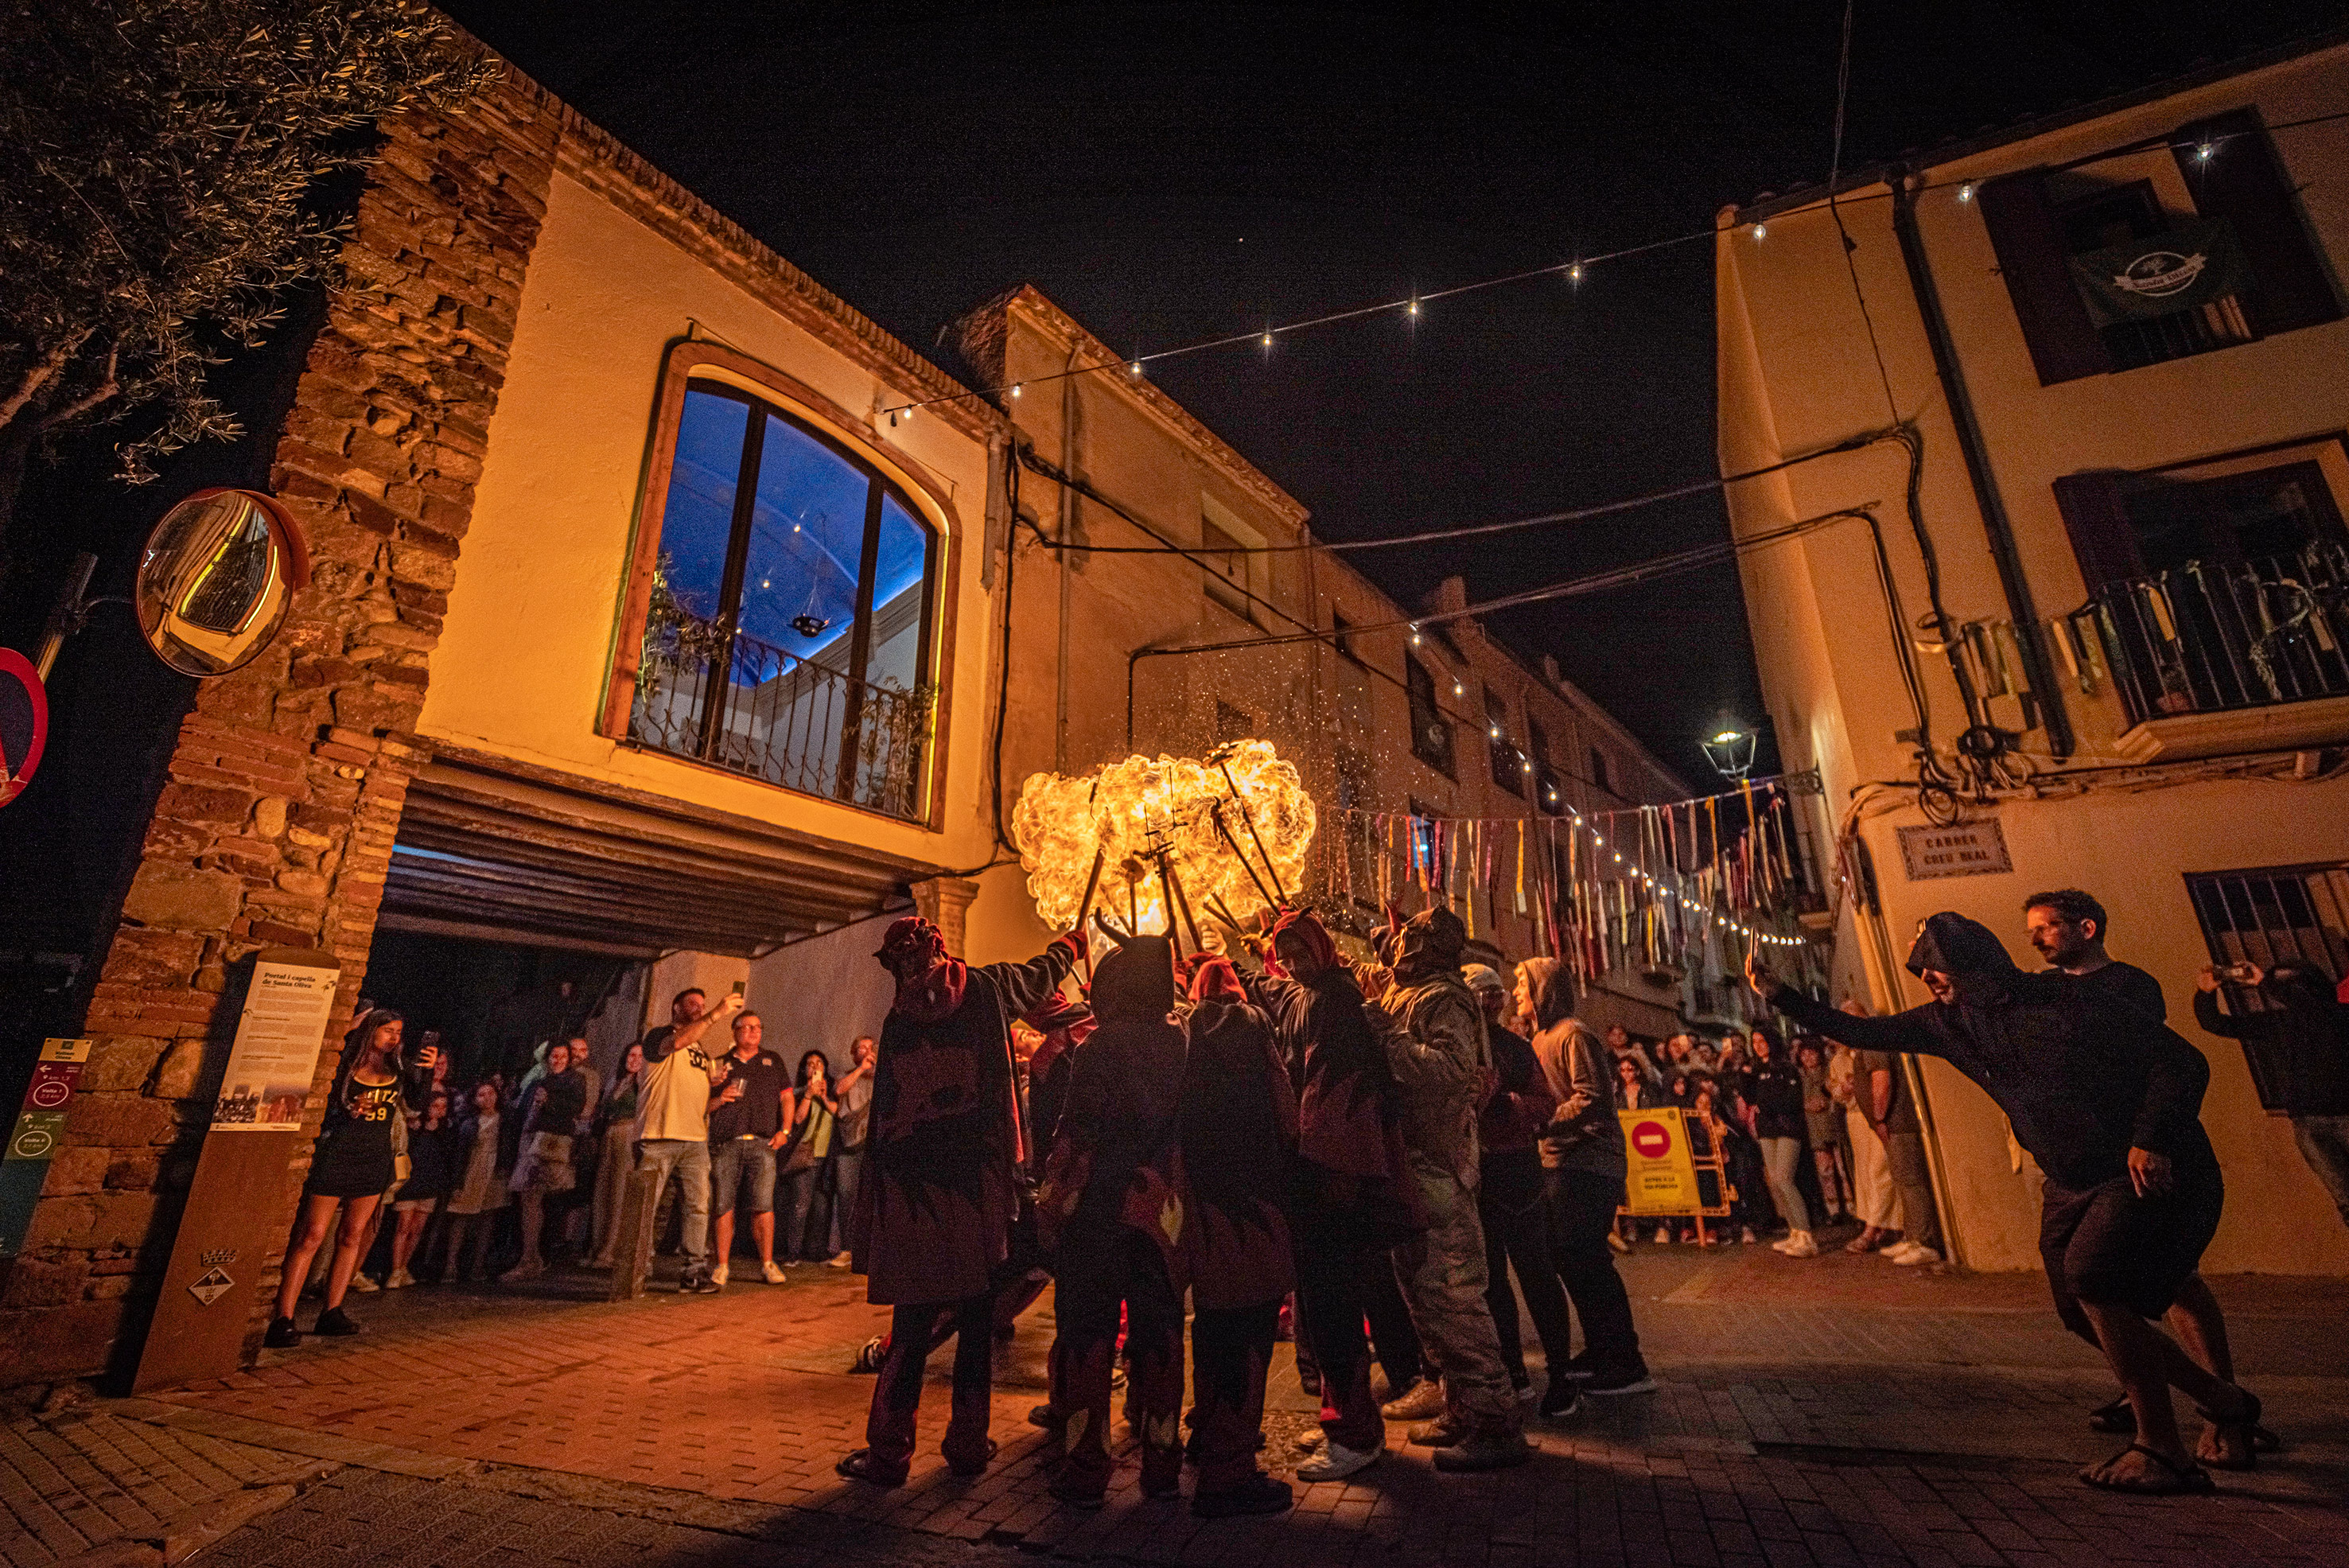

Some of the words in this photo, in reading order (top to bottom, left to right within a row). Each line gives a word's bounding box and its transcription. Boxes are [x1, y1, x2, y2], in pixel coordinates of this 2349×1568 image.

[1926, 835, 1978, 848] CARRER
[1924, 854, 1954, 865] CREU
[1959, 850, 1990, 862] REAL
